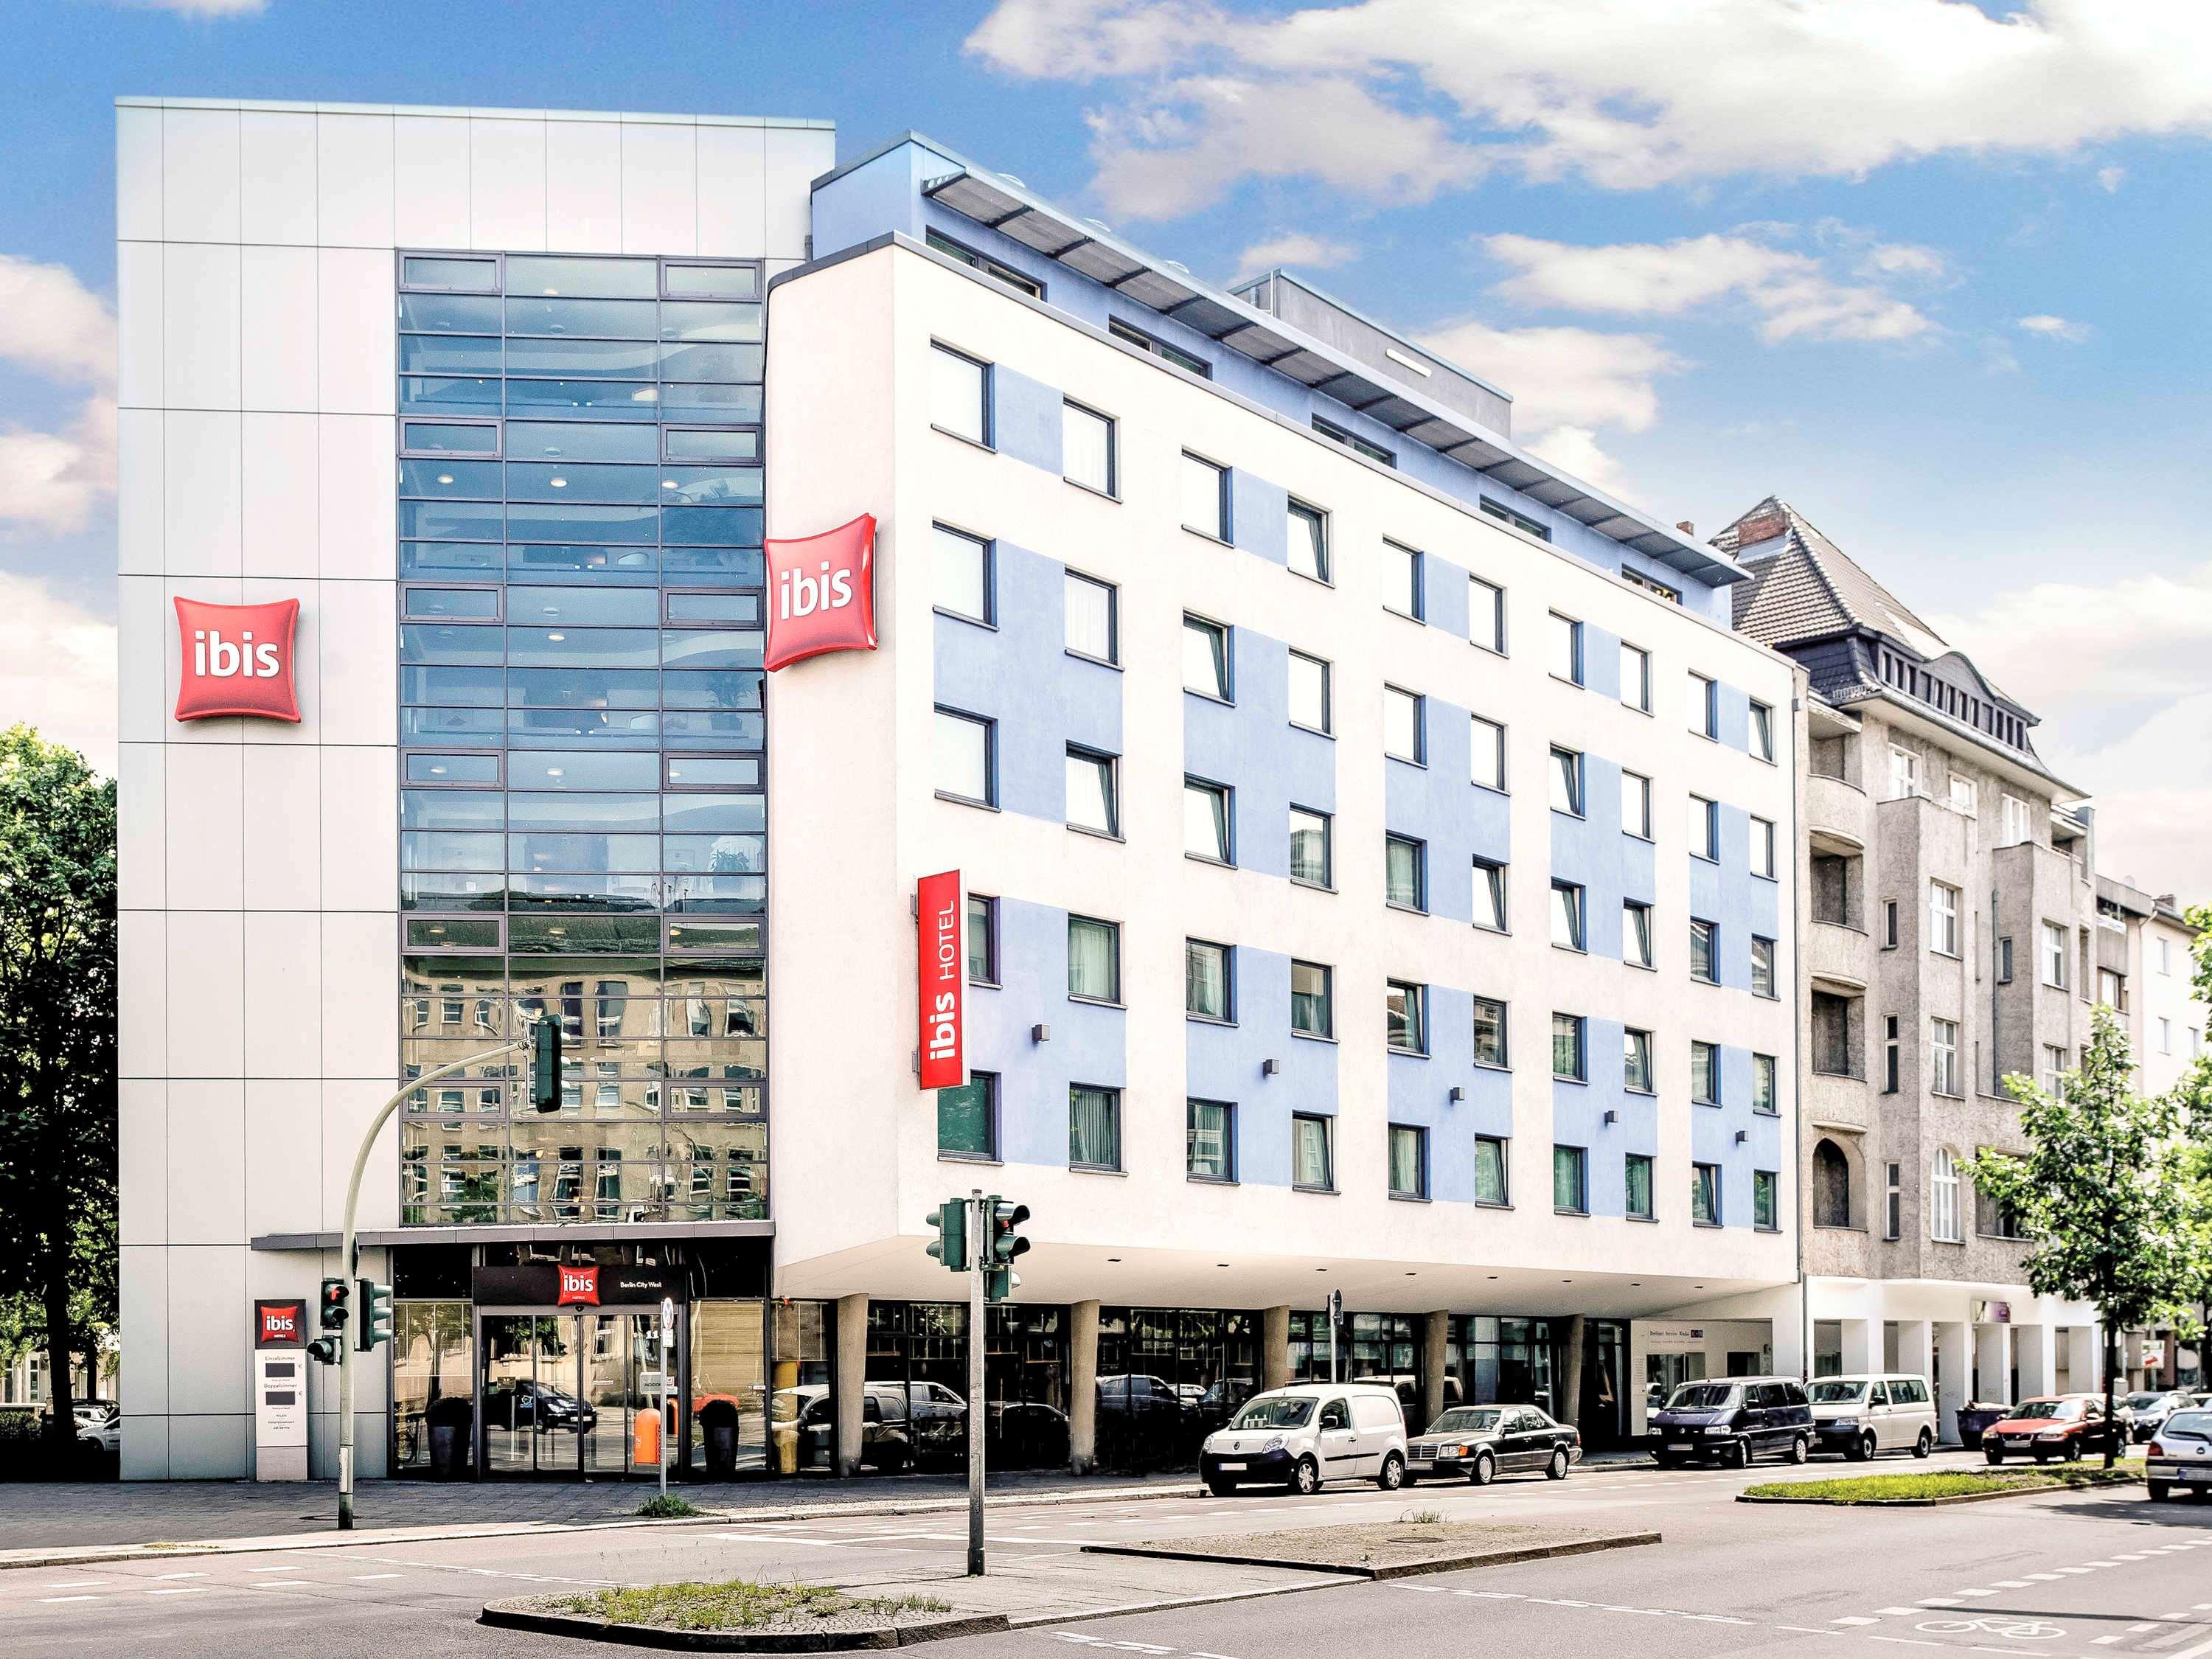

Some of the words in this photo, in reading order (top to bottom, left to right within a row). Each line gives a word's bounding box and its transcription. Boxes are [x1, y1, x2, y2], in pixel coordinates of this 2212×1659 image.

[780, 560, 852, 620] ibis
[195, 630, 280, 678] ibis
[938, 900, 955, 981] HOTEL
[929, 991, 956, 1060] ibis
[563, 1274, 594, 1292] ibis
[266, 1315, 294, 1331] ibis
